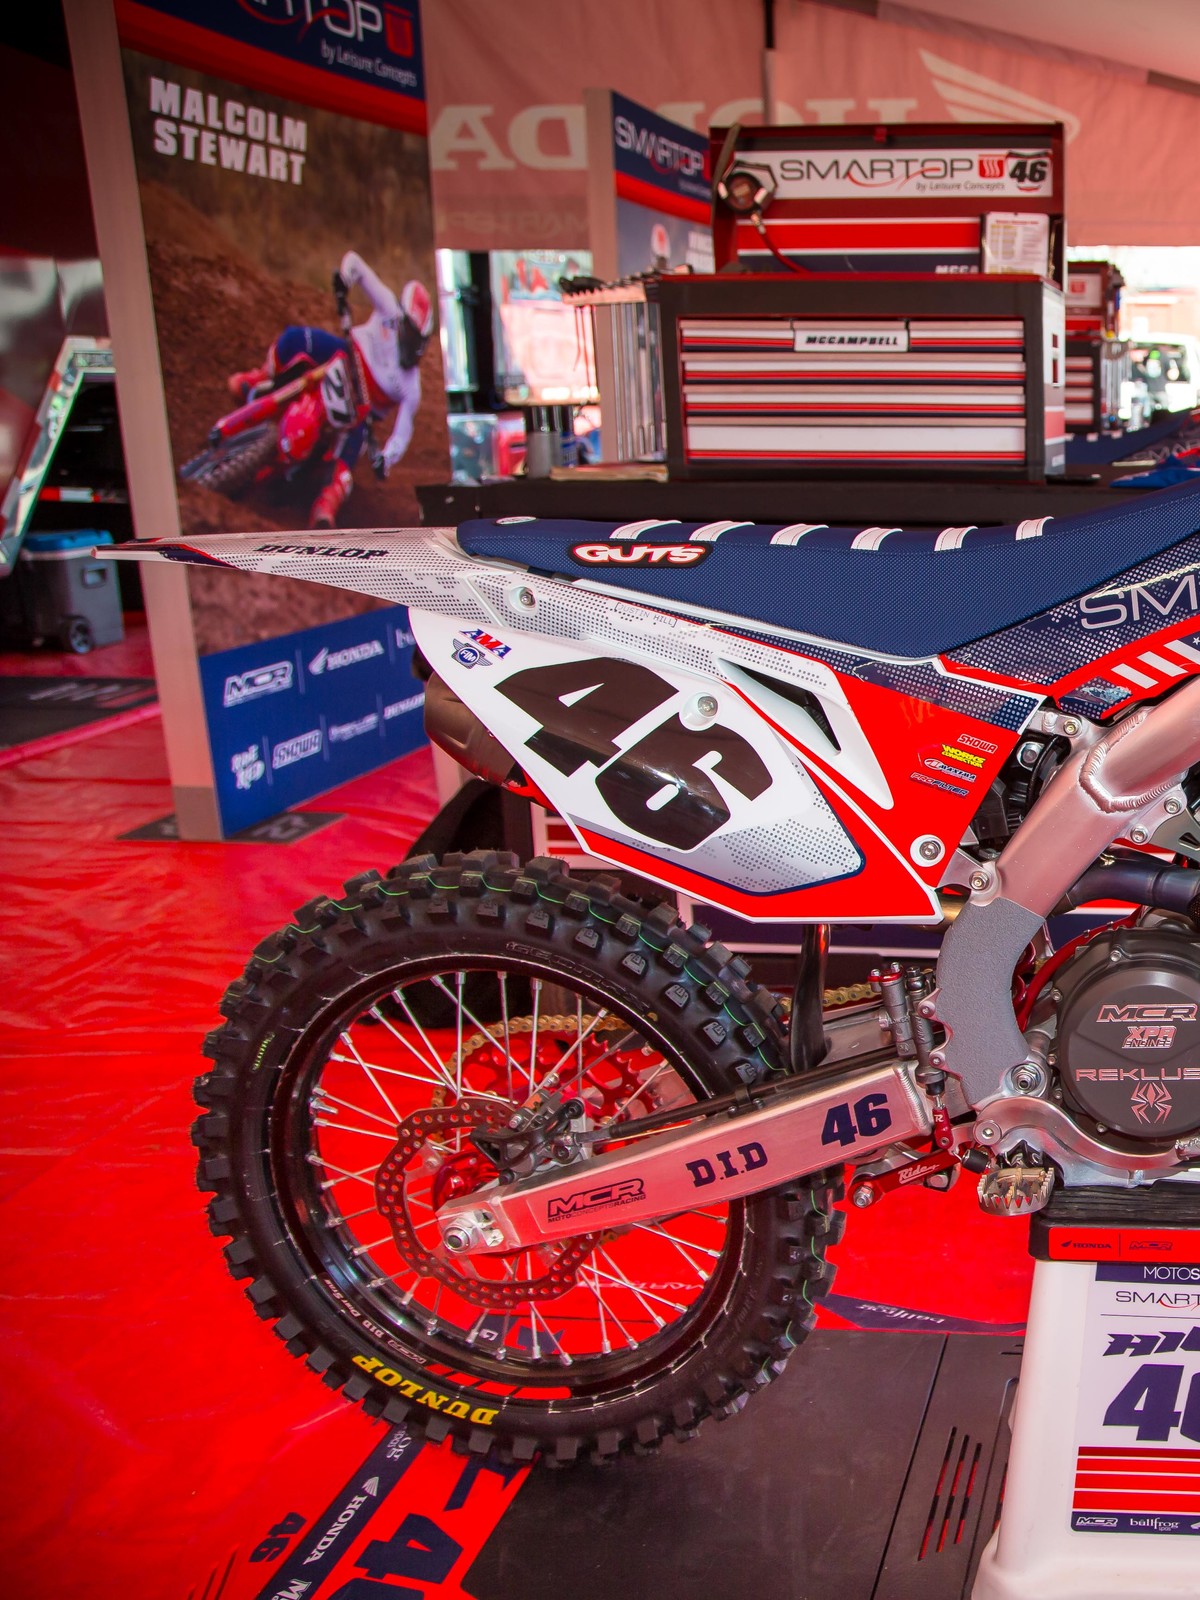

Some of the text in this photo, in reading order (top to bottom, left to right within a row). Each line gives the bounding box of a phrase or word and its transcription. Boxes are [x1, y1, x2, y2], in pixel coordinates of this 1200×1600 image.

[150, 77, 308, 152] MALCOLM
[153, 119, 306, 185] STEWART
[780, 158, 974, 184] SMARTOP
[1009, 159, 1049, 183] 46
[929, 180, 961, 191] Leisure
[963, 180, 1005, 192] Concepts
[806, 335, 900, 347] MCCAMPBELL
[254, 544, 390, 560] DUNLOP
[573, 544, 706, 564] GUTS
[327, 640, 385, 671] HONDA
[459, 628, 512, 659] AMA
[460, 649, 477, 662] FIM
[224, 661, 293, 707] MCR
[493, 657, 773, 851] 46
[942, 744, 986, 763] WORKS
[957, 734, 998, 754] SHOWA
[910, 771, 970, 796] PROFILTER
[938, 763, 977, 781] MAXIMA
[1096, 1003, 1198, 1023] MCR
[1126, 1025, 1177, 1041] XPR
[820, 1093, 892, 1148] 46
[686, 1142, 768, 1187] D.I.D
[548, 1178, 644, 1218] MCR
[351, 1353, 500, 1426] DUNLOP
[303, 1495, 368, 1565] HONDA
[1076, 1516, 1119, 1528] MCR
[249, 1512, 307, 1563] 46
